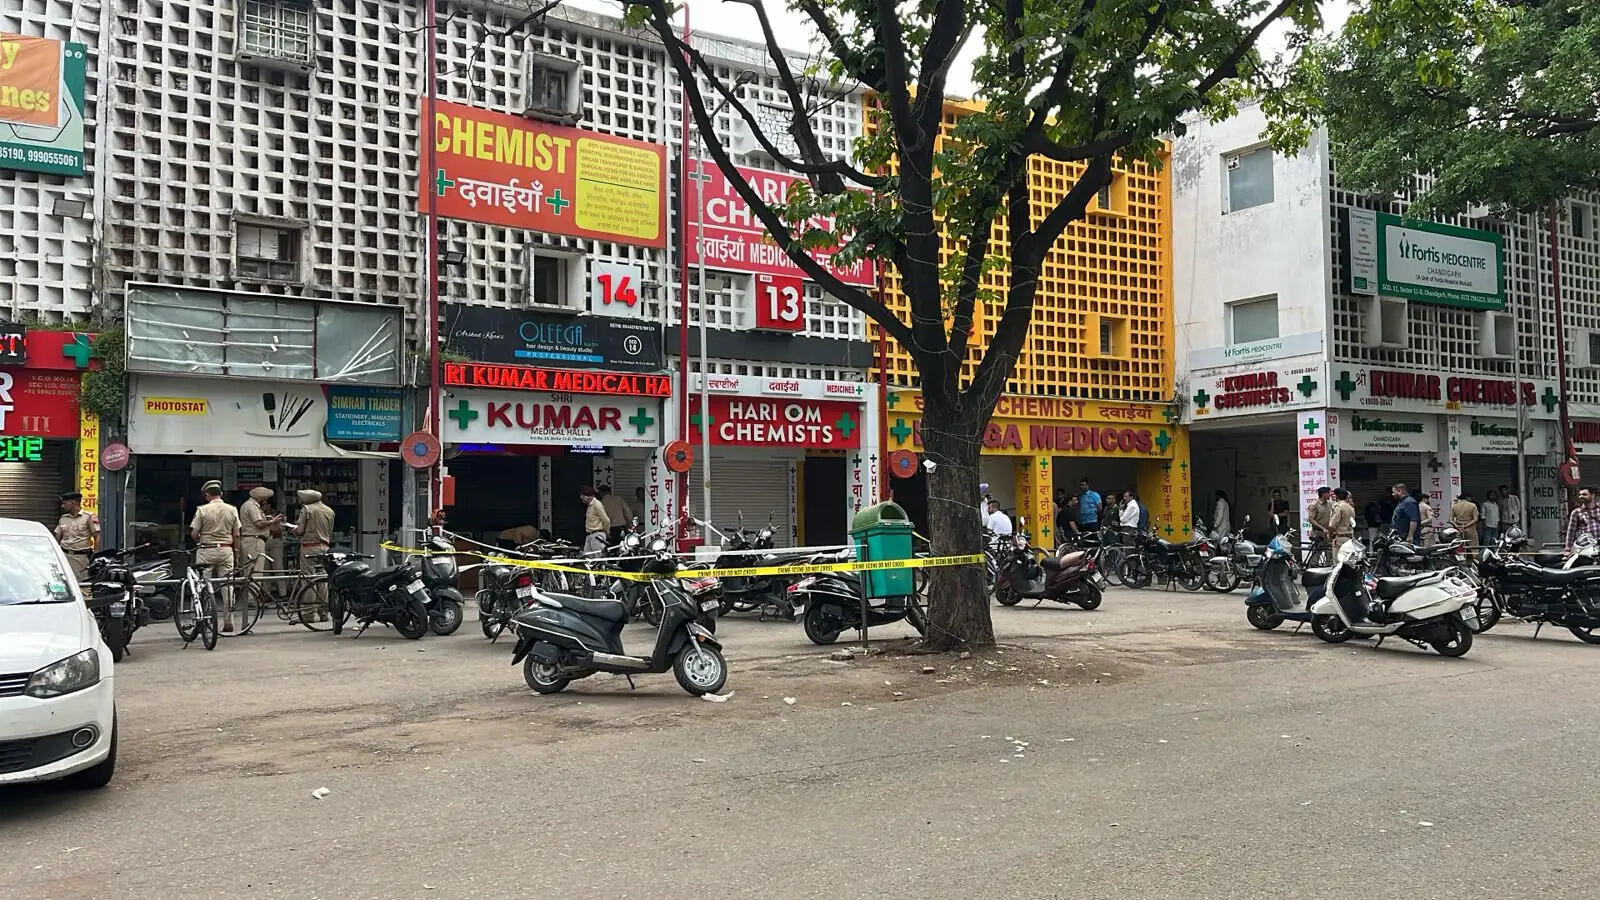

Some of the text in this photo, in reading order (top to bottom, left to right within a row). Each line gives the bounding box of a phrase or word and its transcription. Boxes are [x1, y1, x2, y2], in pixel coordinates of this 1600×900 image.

[435, 112, 571, 174] CHEMIST
[457, 177, 543, 214] दवाईयाँ
[1411, 244, 1486, 270] Fortis MEDCENTRE
[597, 273, 638, 308] 14
[765, 285, 799, 322] 13
[526, 351, 593, 362] PROFESSIONAL
[559, 345, 577, 353] beauty
[1232, 346, 1251, 357] Fortis
[1251, 343, 1283, 354] MEDCENTRE
[473, 366, 548, 390] KUMAR
[553, 371, 640, 395] MEDICAL
[645, 376, 672, 396] HA
[826, 384, 855, 394] MEDICINES
[1224, 371, 1278, 393] KUMAR
[1370, 369, 1537, 406] KUMAR CHEMISS
[147, 400, 206, 413] PHOTOSTAT
[331, 395, 366, 410] SIMRAN
[550, 393, 573, 403] SHRI
[998, 397, 1153, 420] CHEMIST दवाईयाँ
[1214, 387, 1290, 411] CHEMISTS
[487, 401, 622, 432] KUMAR
[729, 401, 822, 423] HARI OM
[530, 427, 565, 436] MEDICAL
[566, 428, 585, 437] HALL
[719, 422, 833, 444] CHEMISTS
[1029, 423, 1153, 453] MEDICOS
[1528, 466, 1557, 480] FORTIS
[1533, 486, 1554, 498] MED
[1530, 506, 1561, 520] CENTRE
